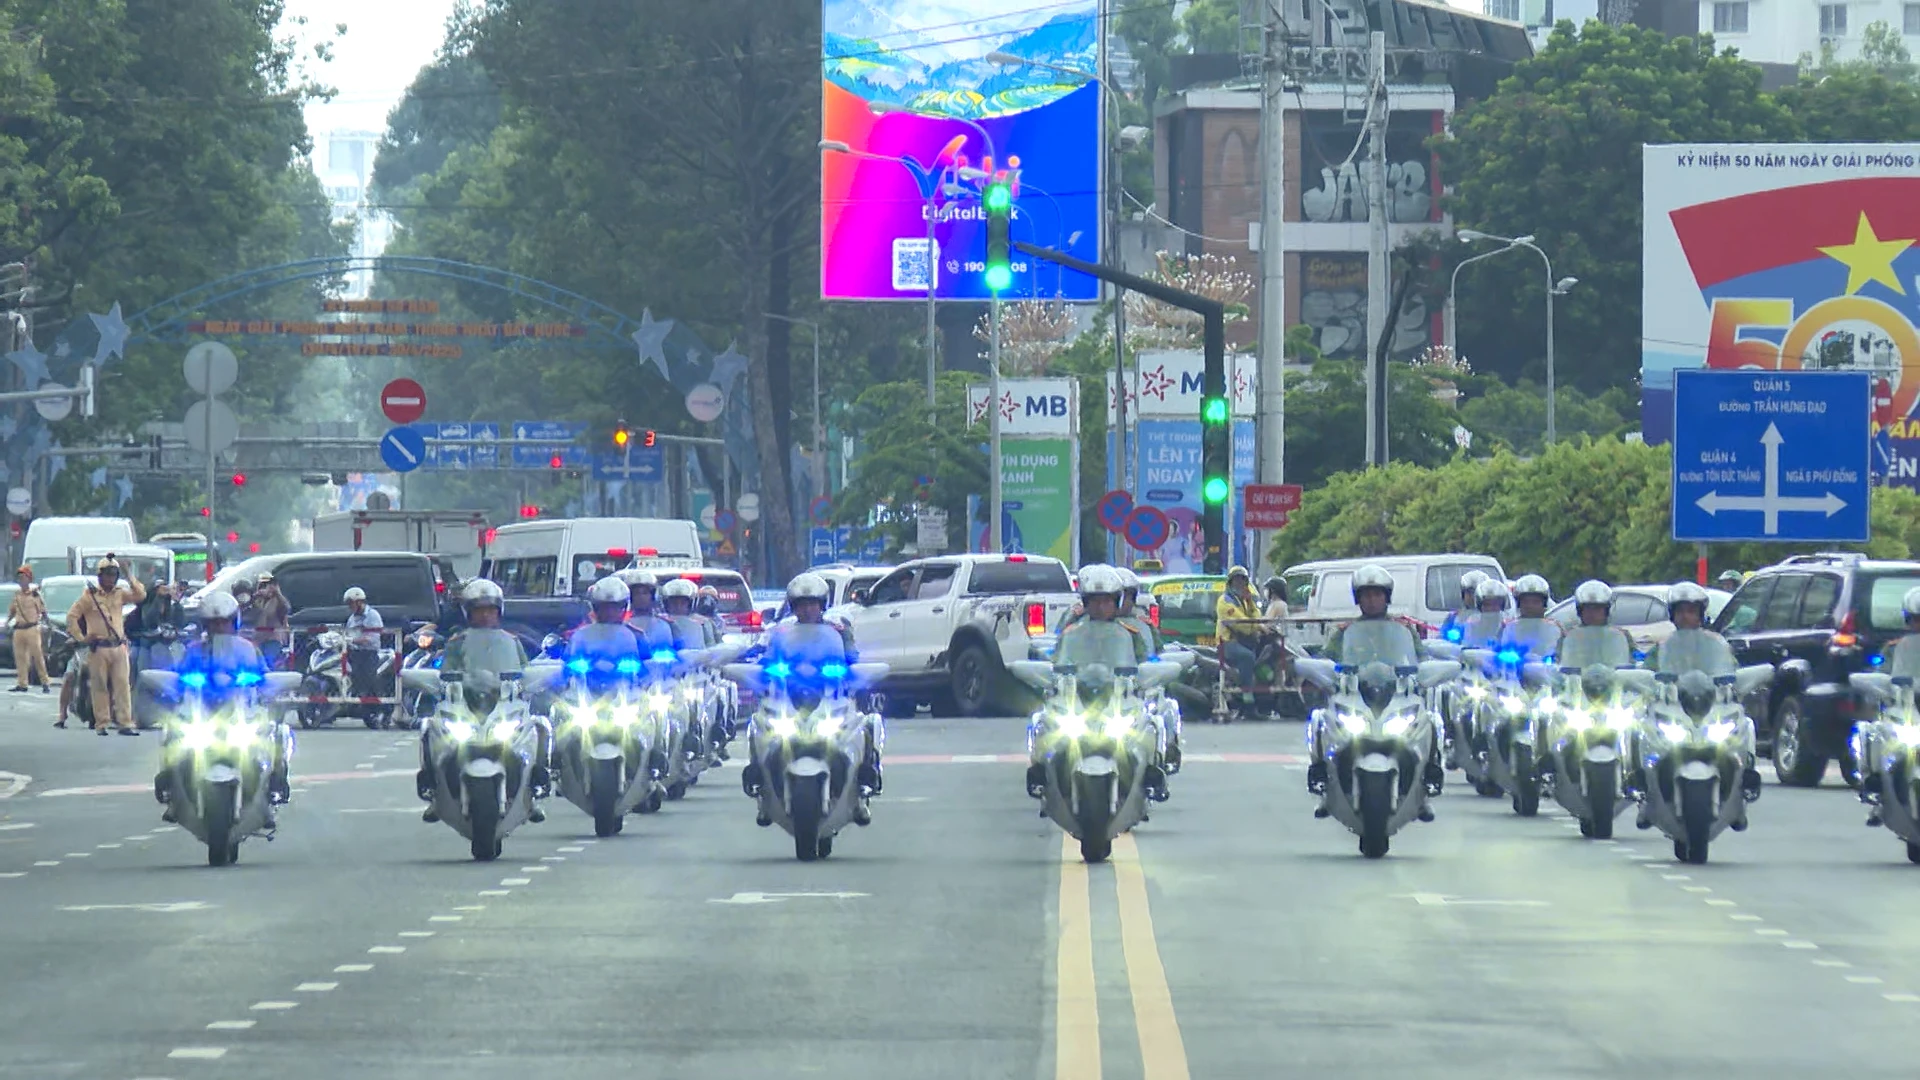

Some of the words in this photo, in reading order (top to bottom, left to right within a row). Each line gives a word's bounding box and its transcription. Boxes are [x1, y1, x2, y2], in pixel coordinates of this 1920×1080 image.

[1699, 151, 1731, 170] NIỆM
[1735, 155, 1751, 167] 50
[1755, 153, 1786, 167] NĂM
[1790, 152, 1828, 167] NGÀY
[1866, 152, 1914, 168] PHÓNG
[1784, 380, 1791, 392] 5
[1025, 395, 1067, 417] MB
[1754, 396, 1779, 413] TRẦN
[644, 431, 656, 447] 3
[1147, 443, 1183, 464] LÊN
[1700, 448, 1729, 465] QUẬN
[1021, 455, 1059, 470] DỤNG
[1147, 467, 1195, 484] NGAY
